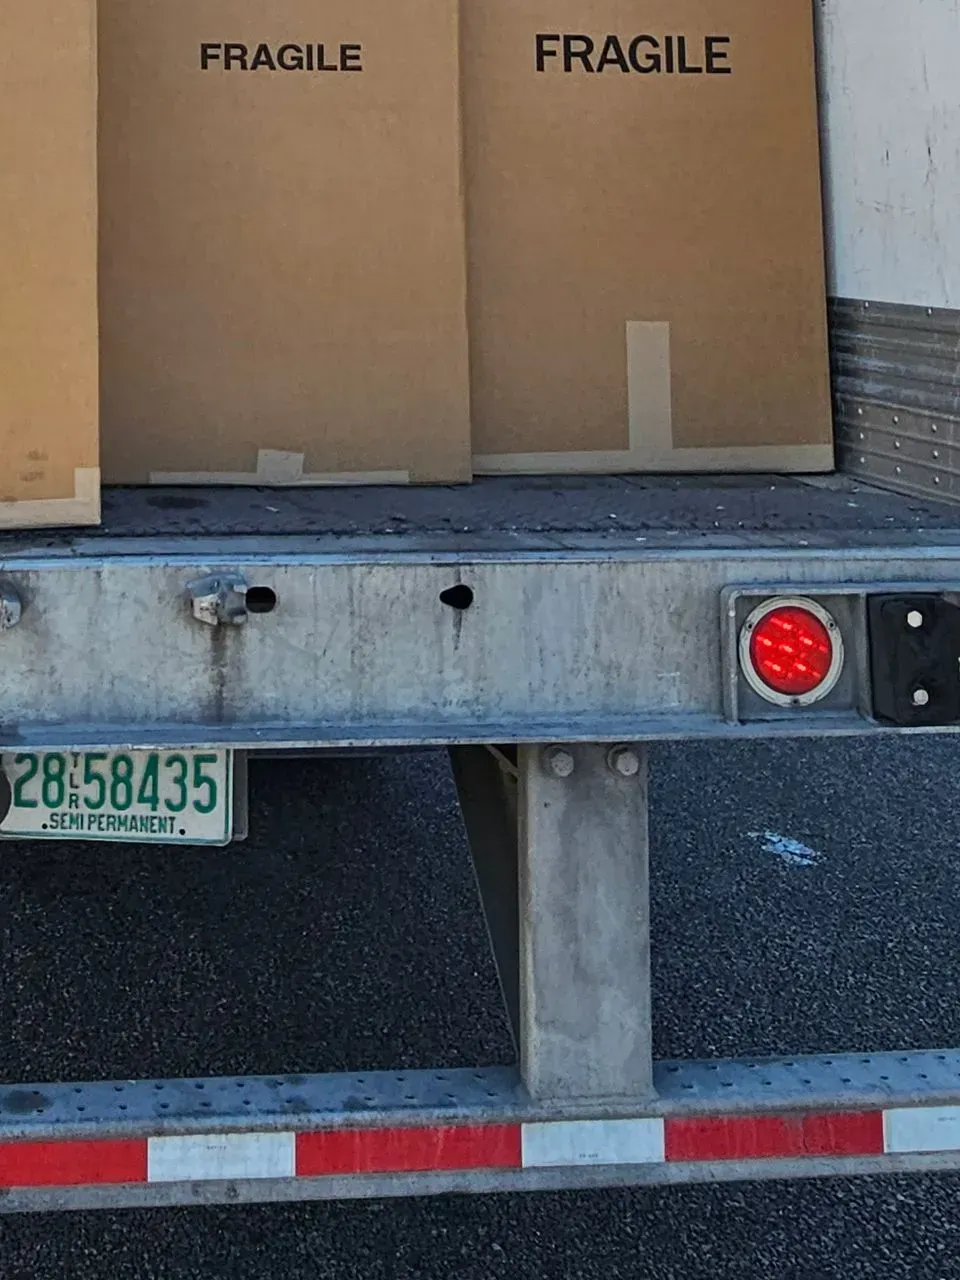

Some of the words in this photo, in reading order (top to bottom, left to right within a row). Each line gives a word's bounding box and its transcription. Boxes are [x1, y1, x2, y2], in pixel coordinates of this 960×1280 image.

[201, 43, 363, 72] FRAGILE
[536, 33, 732, 74] FRAGILE
[13, 751, 66, 809] 28
[83, 752, 218, 814] 58435
[49, 812, 85, 831] SEMI
[87, 814, 176, 835] PERMANENT
